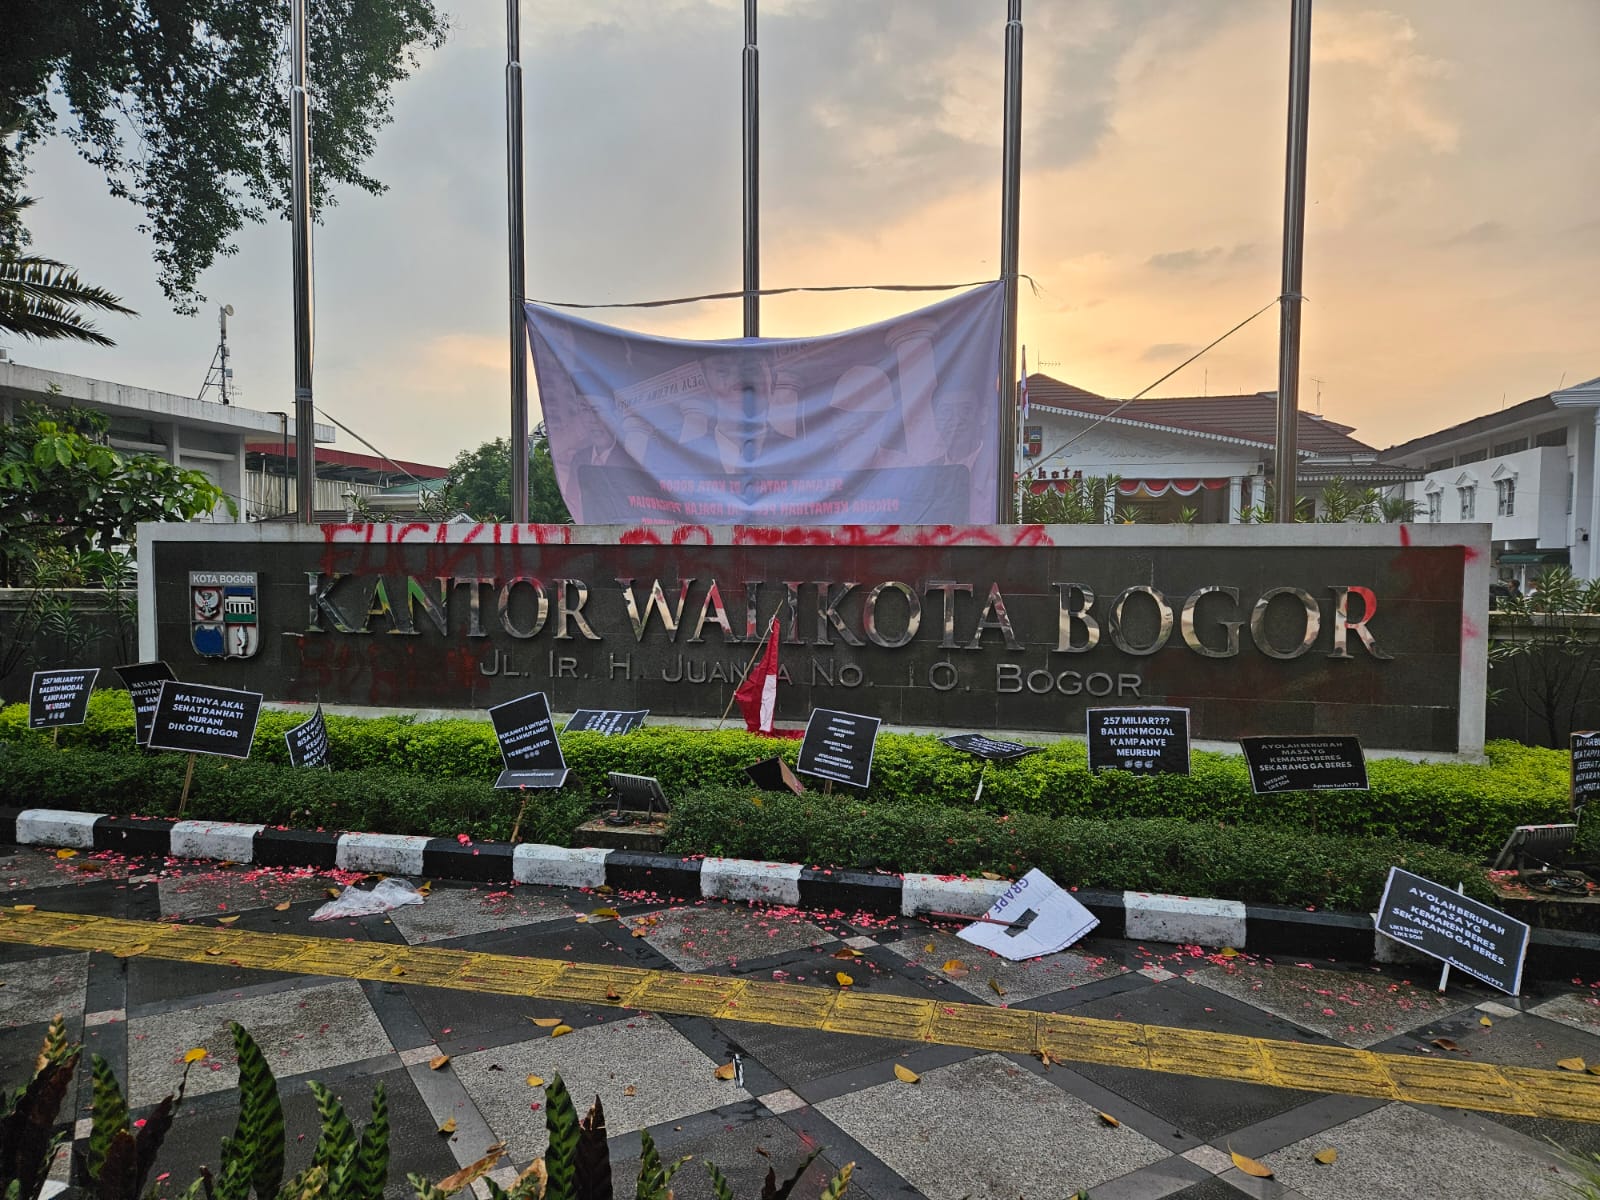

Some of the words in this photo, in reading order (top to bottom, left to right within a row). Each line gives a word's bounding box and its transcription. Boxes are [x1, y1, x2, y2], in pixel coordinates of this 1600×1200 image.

[192, 574, 218, 584] KOTA
[220, 574, 254, 584] BOGOR
[304, 571, 602, 641] KANTOR
[614, 577, 1025, 651] WALIKOTA
[1052, 582, 1395, 661] BOGOR
[662, 653, 793, 685] JUANA
[43, 693, 76, 702] KAMPANYE
[174, 693, 219, 707] MATINYA
[220, 700, 245, 710] AKAL
[172, 703, 202, 714] SEHAT
[202, 707, 222, 717] DAN
[222, 709, 244, 720] HATI
[188, 715, 224, 727] NURANI
[1103, 717, 1120, 725] 257
[1122, 716, 1170, 725] MILIAR???
[178, 723, 206, 734] KOTA
[206, 727, 239, 739] BOGOR
[1100, 727, 1138, 736] BALIKIN
[1140, 727, 1175, 736] MODAL
[1110, 738, 1166, 747] KAMPANYE
[1116, 749, 1161, 757] MEUREUN
[1259, 763, 1309, 772] SEKARANG
[1309, 762, 1325, 770] GA
[1408, 887, 1457, 911] AYOLAH
[1456, 906, 1505, 936] BERUBAH
[1429, 904, 1463, 925] MASA
[1463, 920, 1482, 934] YG
[1392, 907, 1454, 940] SEKARANG
[1455, 934, 1472, 949] GA
[1410, 905, 1464, 934] KEMAREN
[1464, 930, 1496, 951] BERES
